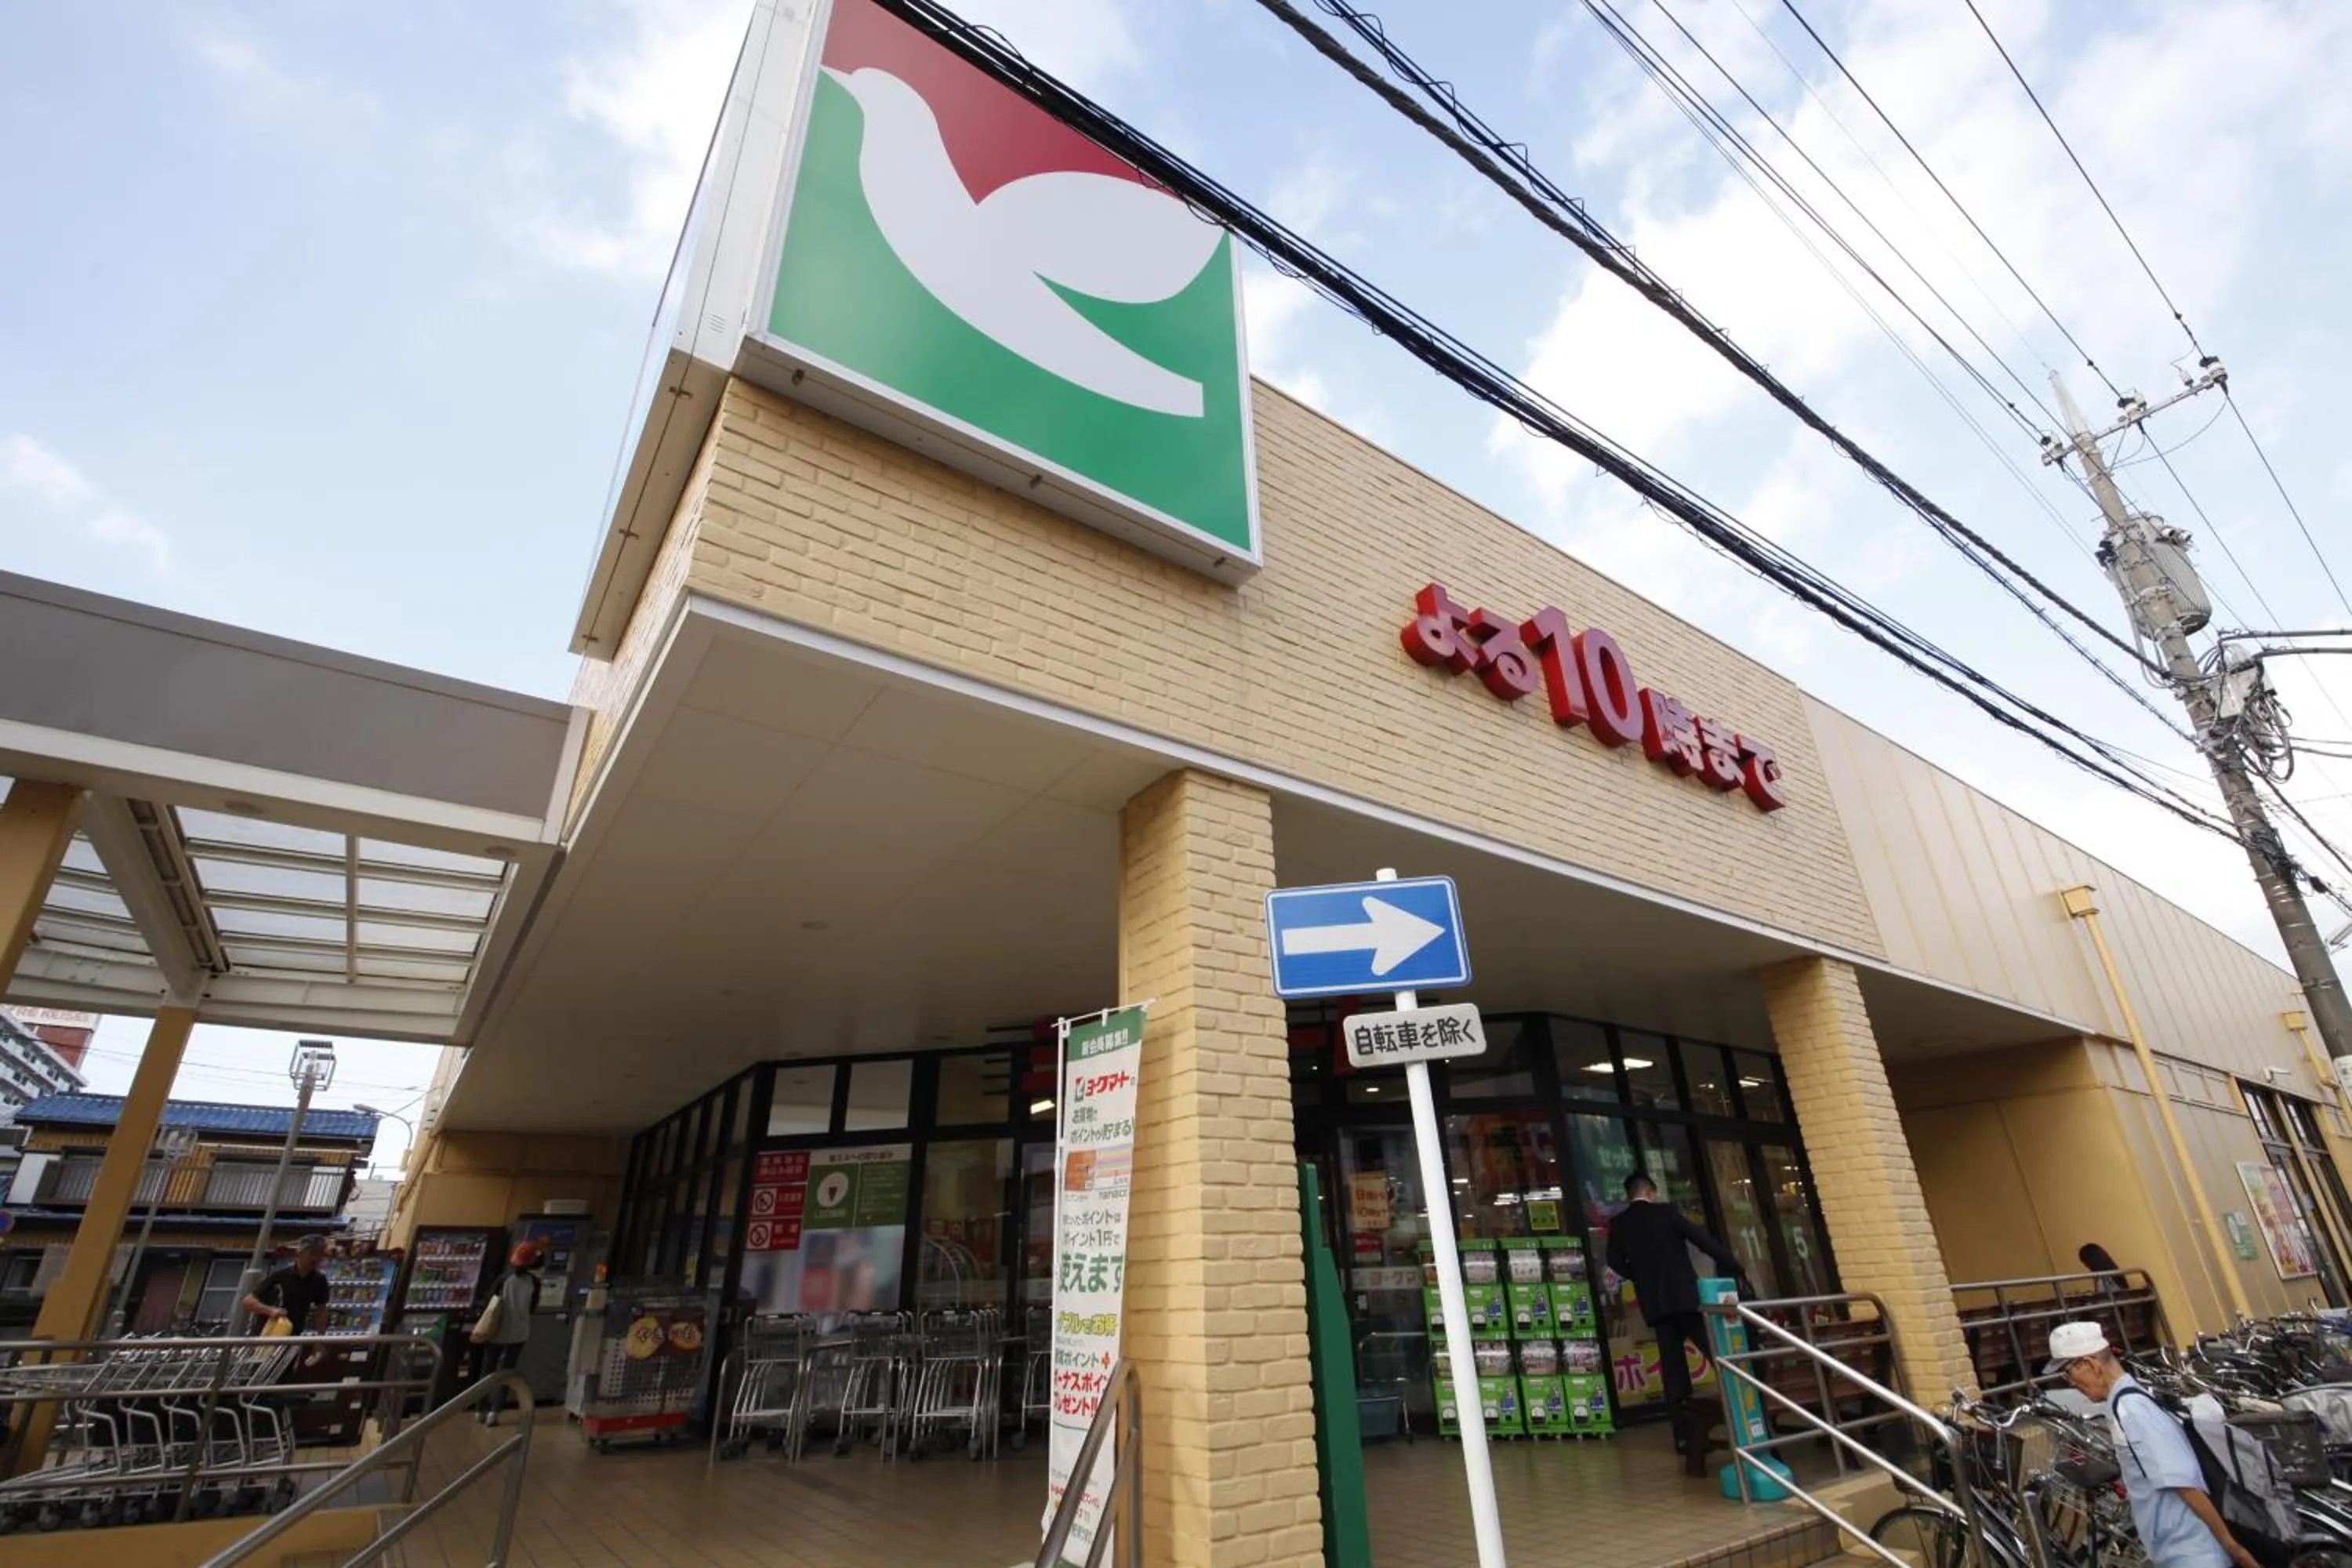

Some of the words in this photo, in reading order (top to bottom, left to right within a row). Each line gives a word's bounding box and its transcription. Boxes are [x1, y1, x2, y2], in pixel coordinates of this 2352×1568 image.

[1400, 583, 1786, 812] よる10時まで
[1354, 1016, 1476, 1056] 自転車を除く
